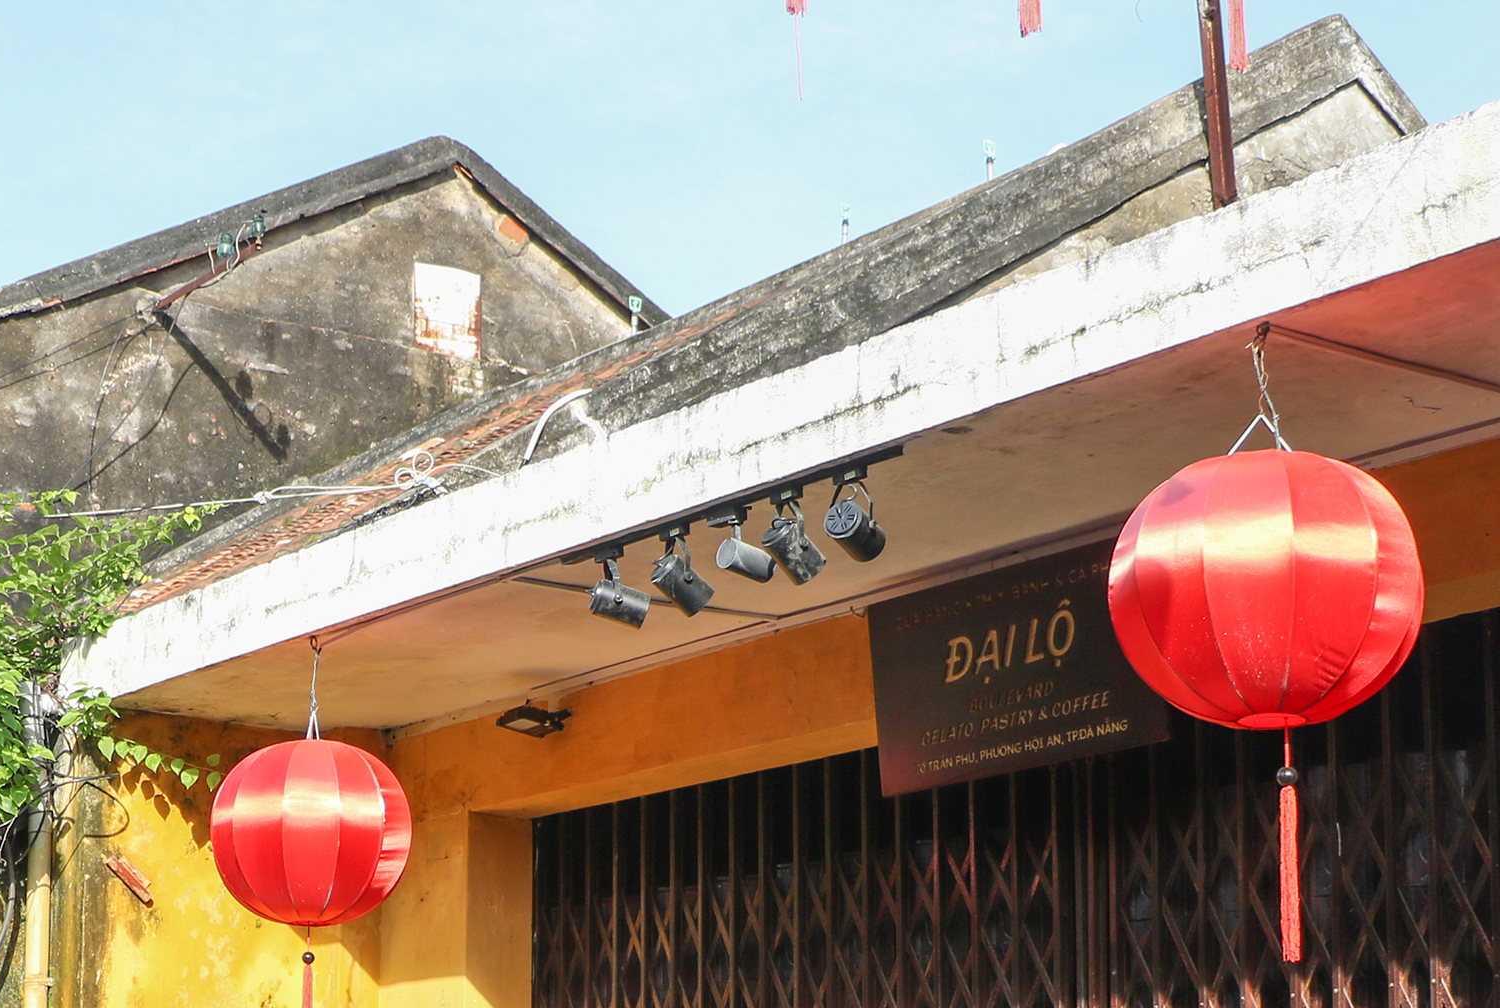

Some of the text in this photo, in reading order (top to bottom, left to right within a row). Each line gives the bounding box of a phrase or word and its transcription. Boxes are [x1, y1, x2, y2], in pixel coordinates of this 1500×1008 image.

[945, 598, 1075, 684] ĐẠI LỘ
[921, 690, 1111, 747] GELATO, PASTRY & COFFEE
[969, 680, 1054, 714] BOULEVARD
[1024, 734, 1044, 753] HỘI
[1046, 733, 1065, 747] AN,
